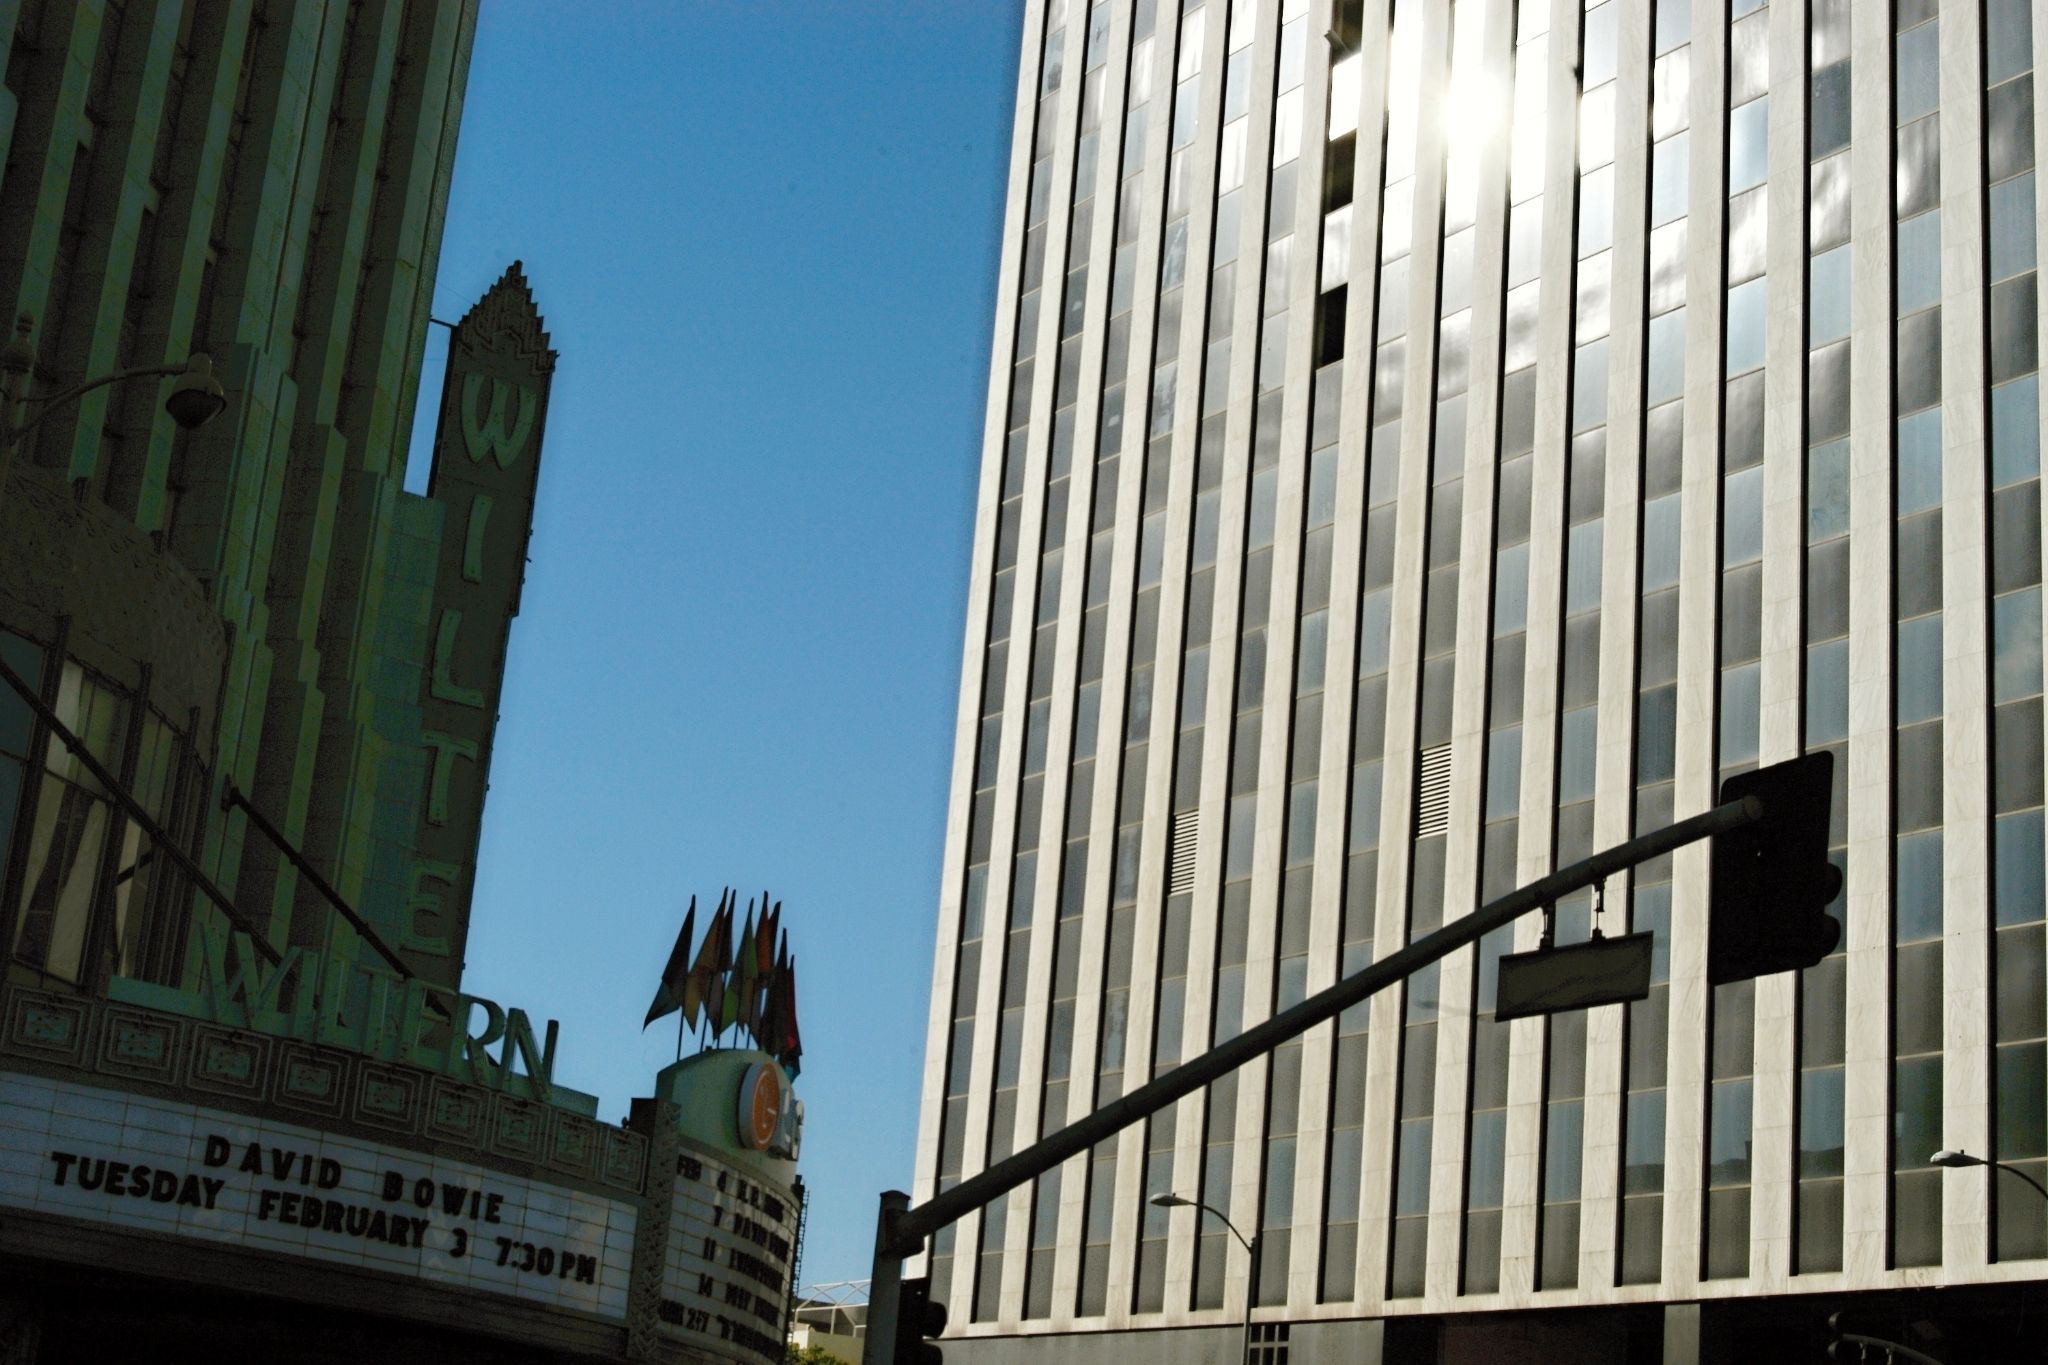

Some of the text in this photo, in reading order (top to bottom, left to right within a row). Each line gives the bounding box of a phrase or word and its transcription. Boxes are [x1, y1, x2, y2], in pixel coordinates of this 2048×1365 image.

[200, 923, 559, 1101] WILTERN
[52, 1151, 225, 1209] TUESDAY
[259, 1189, 429, 1247] FEBRUARY
[450, 1228, 467, 1257] 3
[559, 1251, 596, 1284] PM
[204, 1134, 503, 1223] DAVID BOWIE
